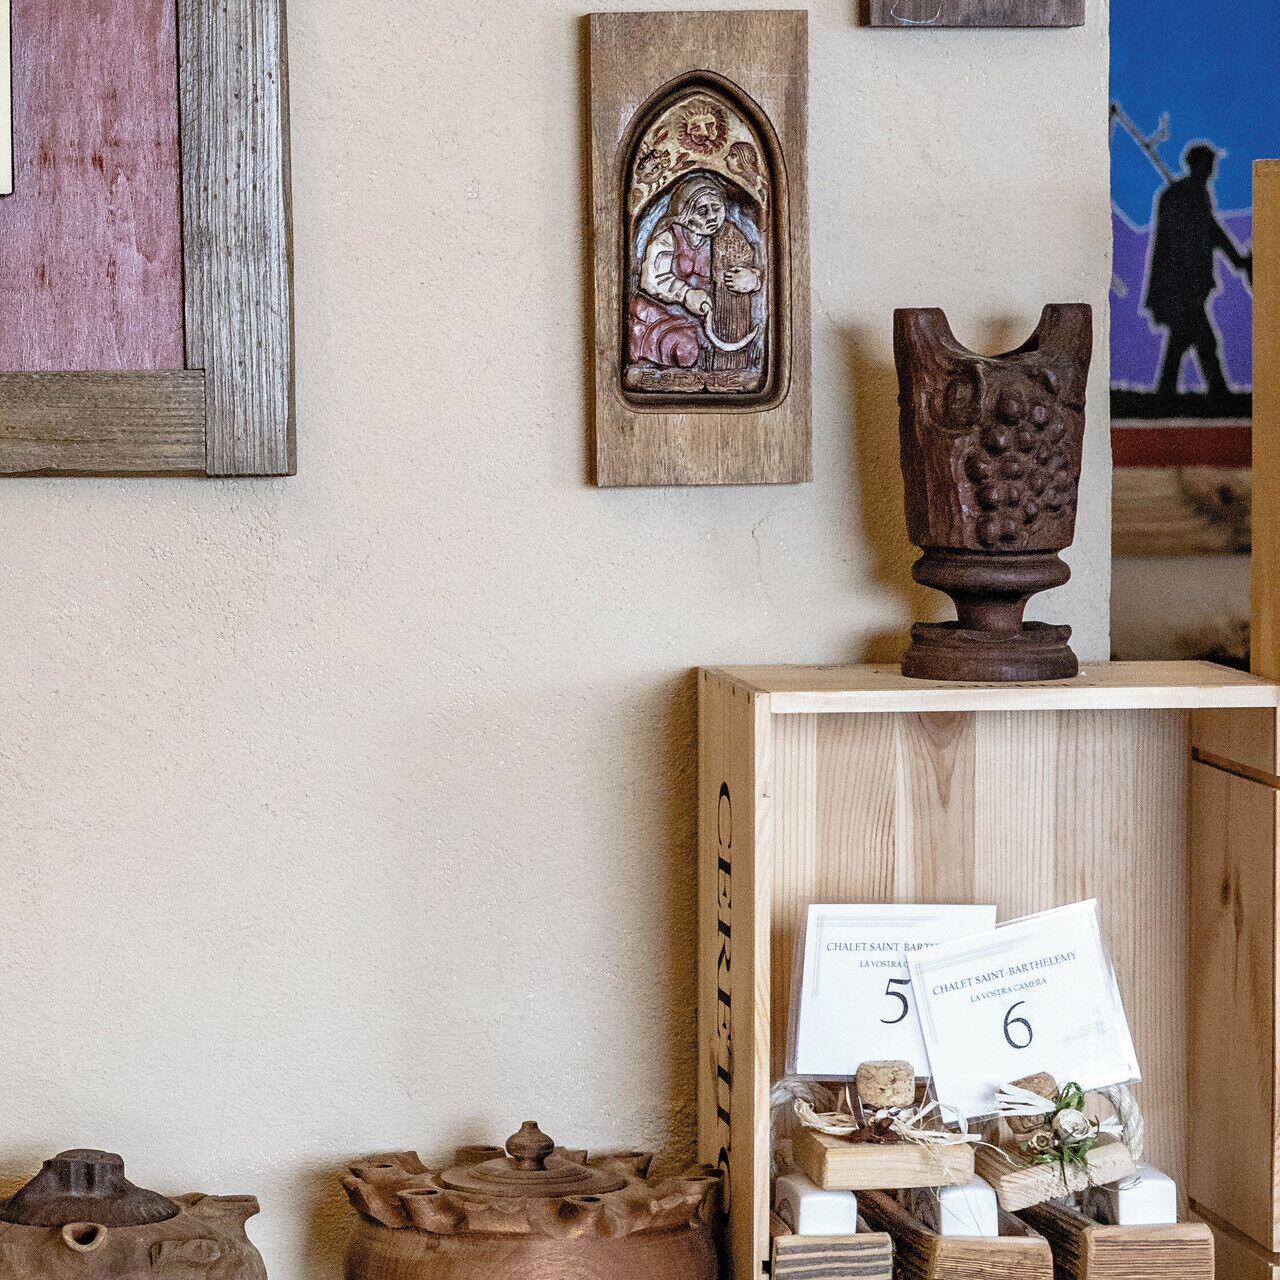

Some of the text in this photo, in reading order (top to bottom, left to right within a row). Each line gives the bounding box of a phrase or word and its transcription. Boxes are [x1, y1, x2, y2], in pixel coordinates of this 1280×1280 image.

[640, 368, 741, 389] ESTATE
[826, 942, 868, 952] CHALET
[870, 960, 902, 968] VOSTRA
[932, 977, 973, 996] CHALET
[981, 986, 1013, 1001] VOSTRA
[1013, 977, 1048, 993] CAMERA
[880, 978, 911, 1024] 5
[1003, 1000, 1034, 1050] 6
